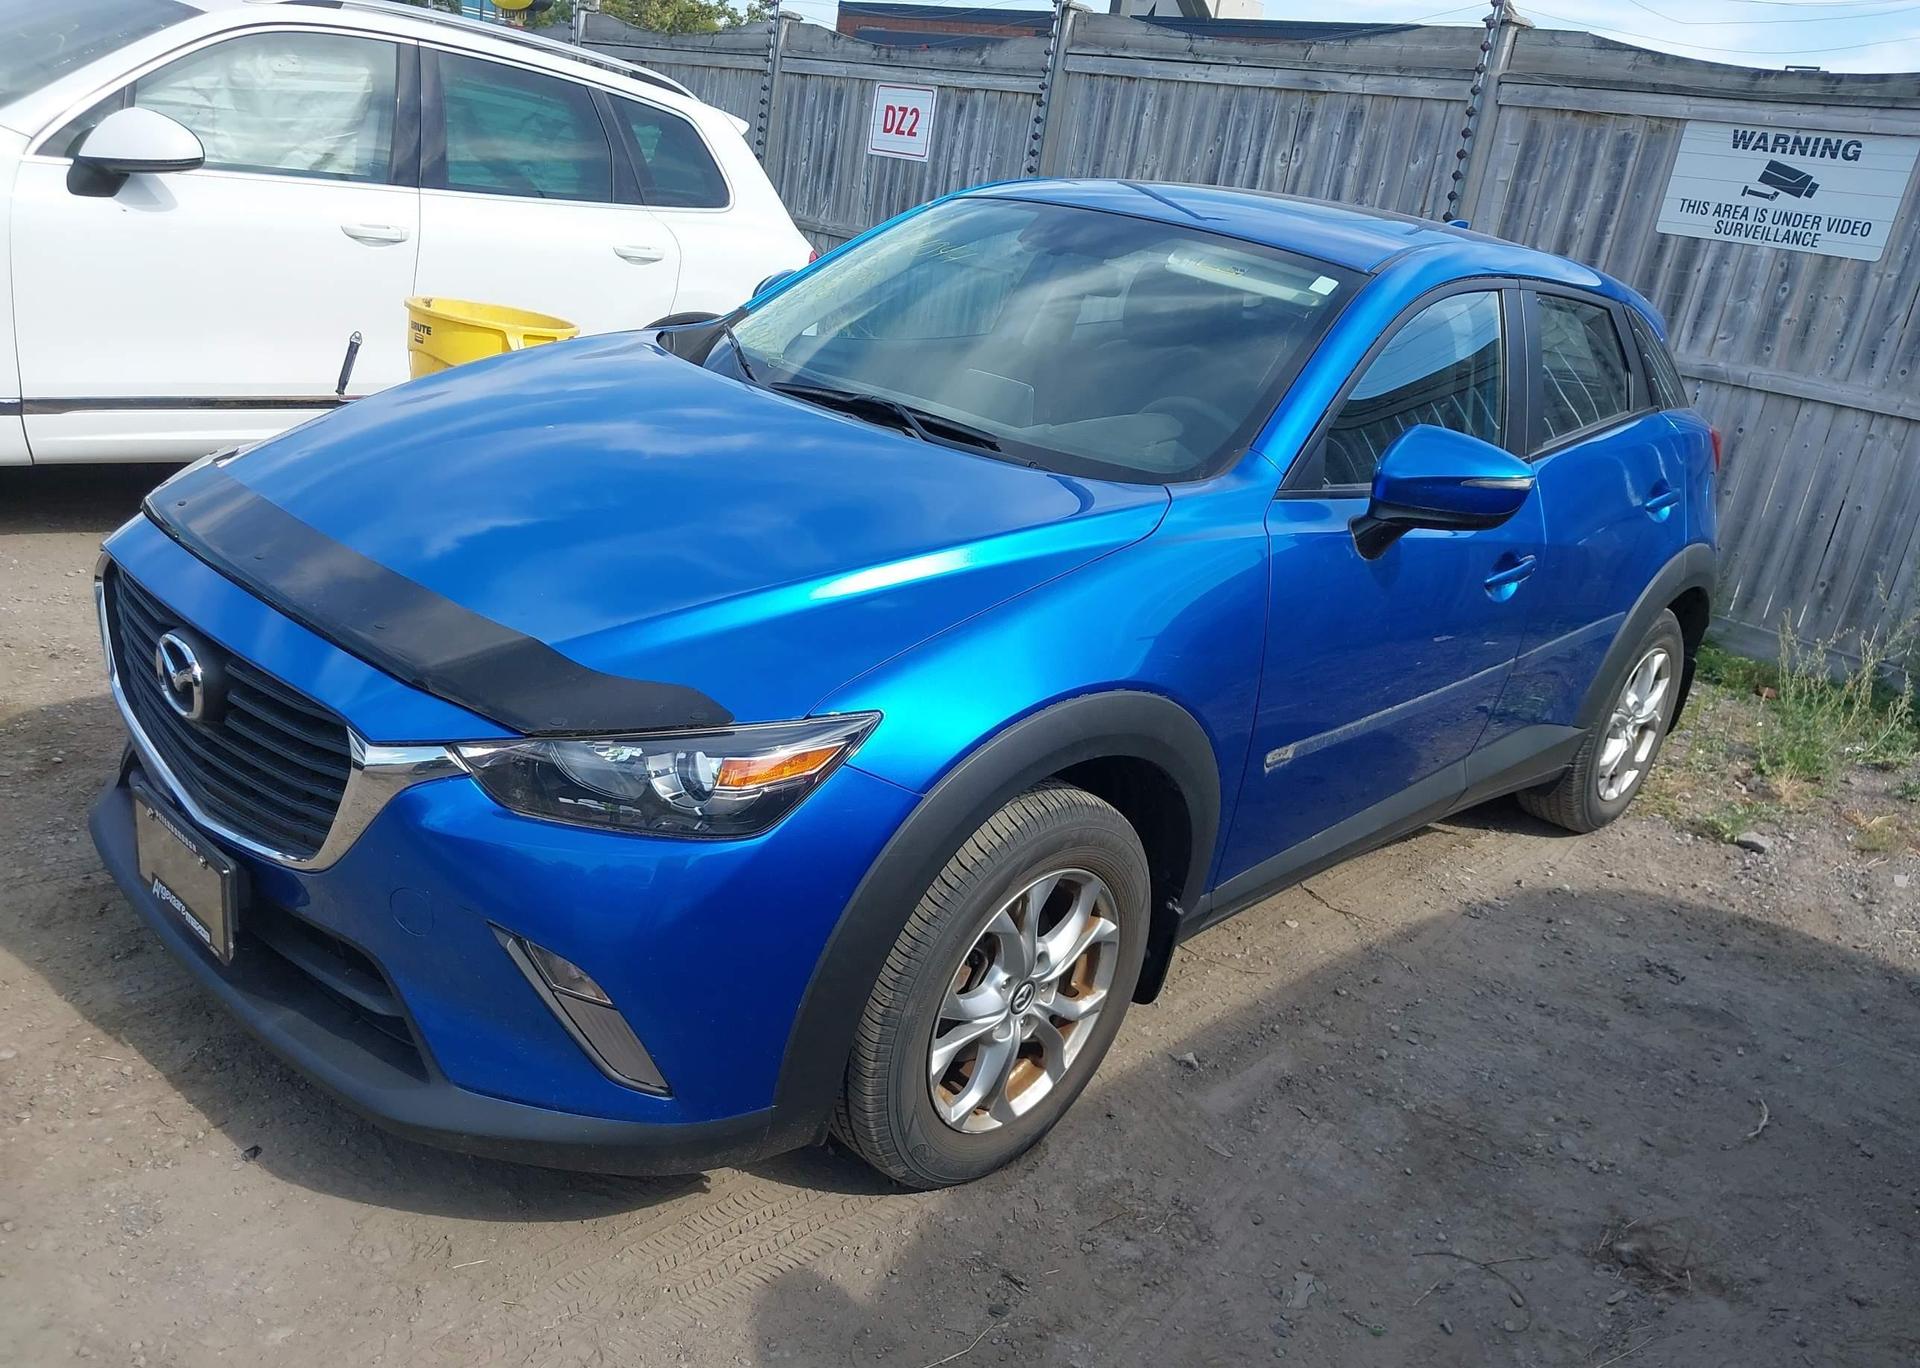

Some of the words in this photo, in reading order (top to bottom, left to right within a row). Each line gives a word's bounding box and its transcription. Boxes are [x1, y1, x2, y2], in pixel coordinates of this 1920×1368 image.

[882, 105, 920, 137] DZ2
[1731, 129, 1863, 162] WARNING
[1679, 198, 1710, 216] THIS
[1712, 203, 1749, 221] AREA
[1753, 207, 1768, 223] IS
[1772, 210, 1822, 231] UNDER
[1827, 217, 1872, 238] VIDEO
[1714, 220, 1821, 249] SURVEILLANCE
